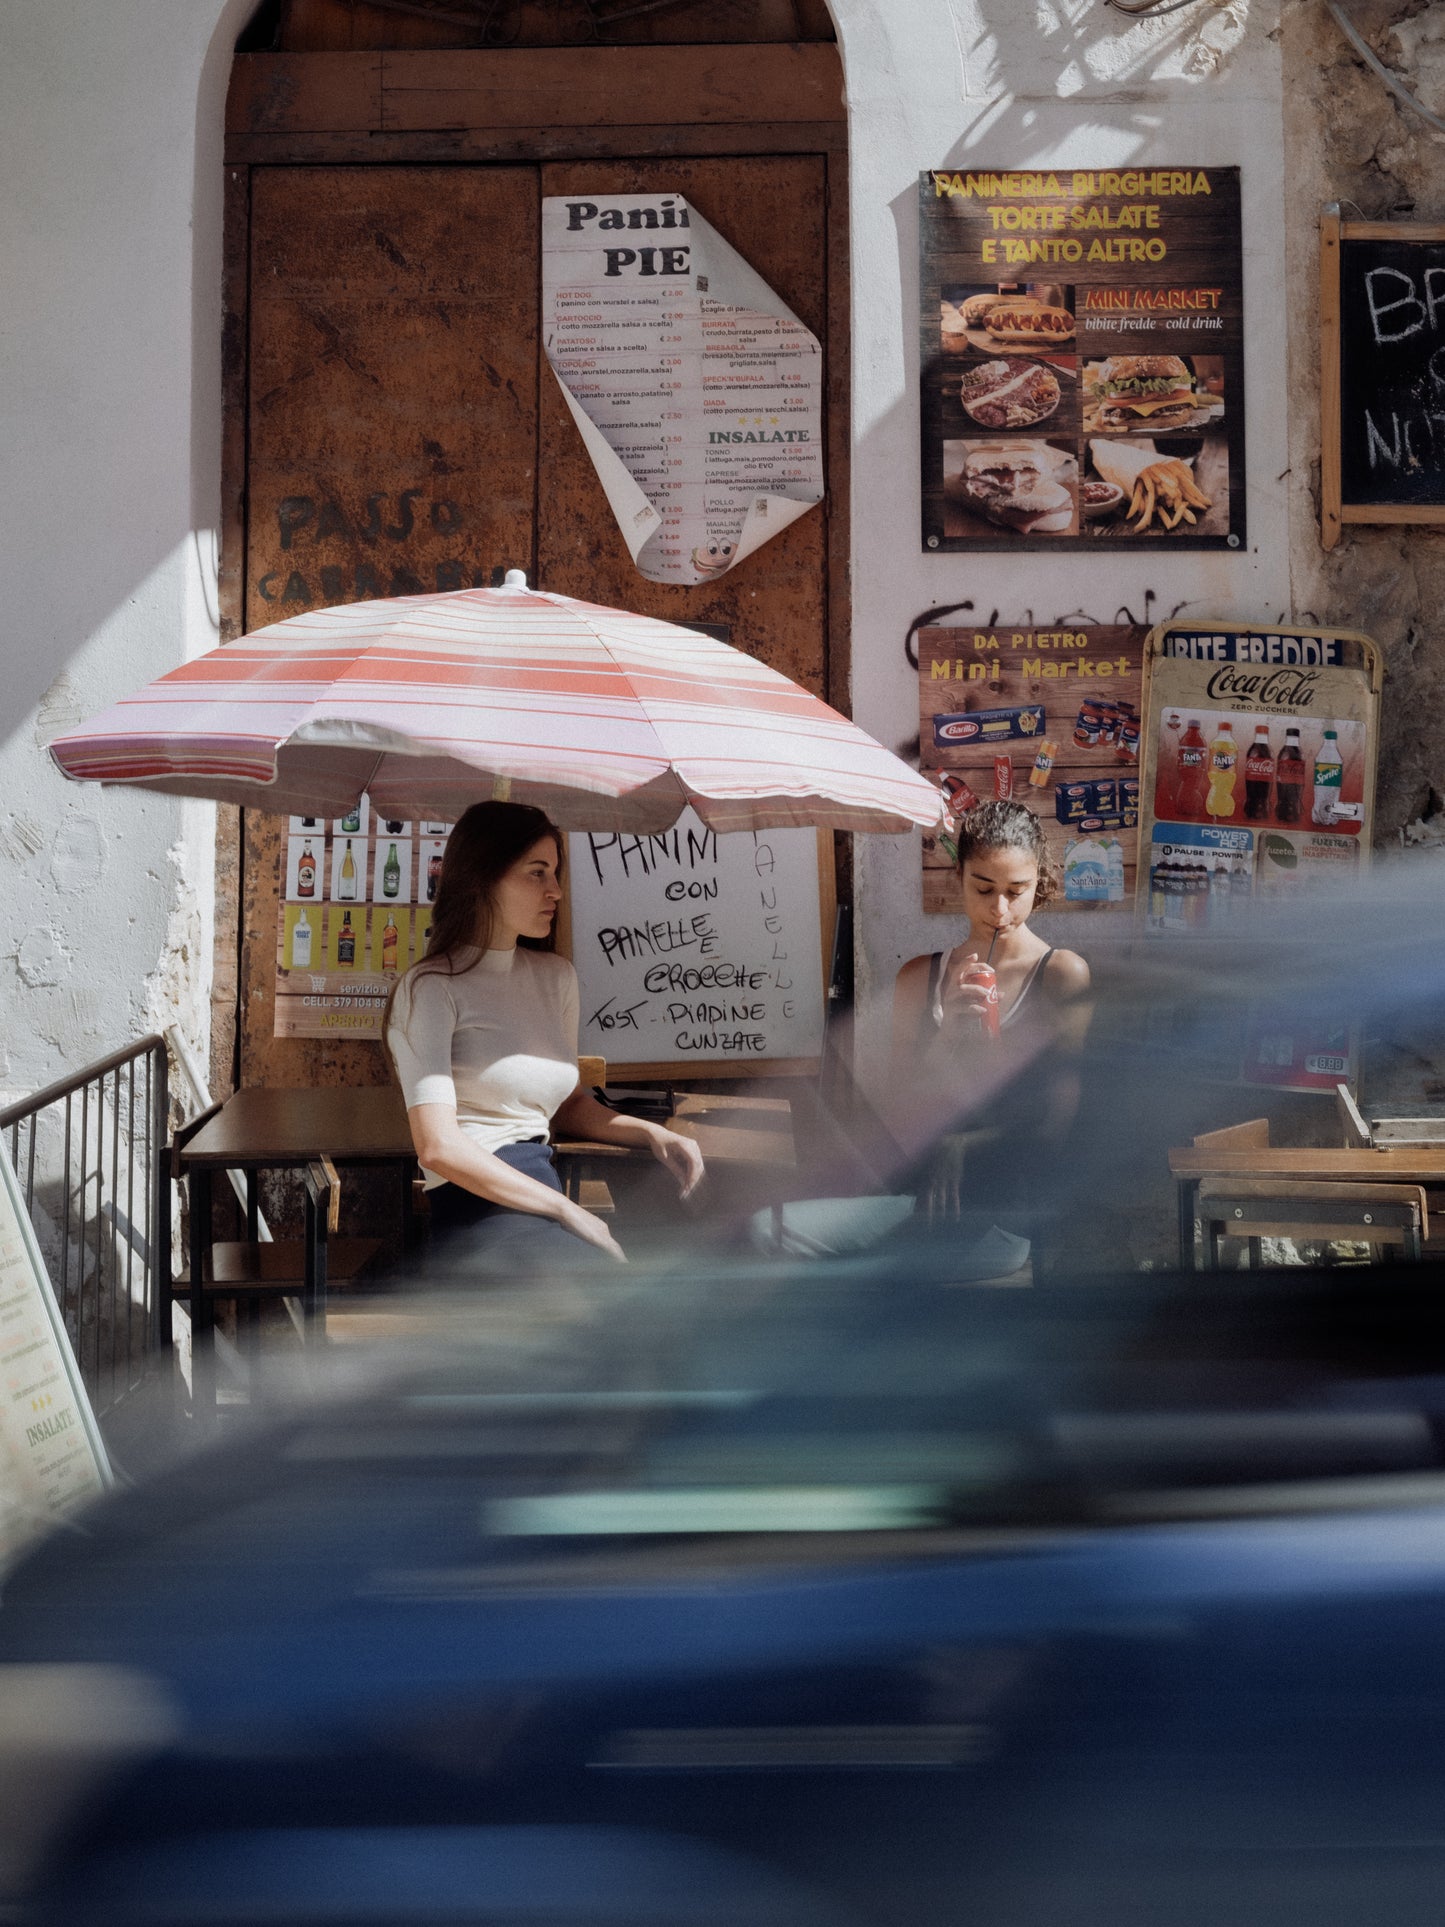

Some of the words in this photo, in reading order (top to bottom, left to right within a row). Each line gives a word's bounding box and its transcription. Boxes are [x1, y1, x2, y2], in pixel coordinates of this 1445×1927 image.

[1072, 171, 1212, 197] BURGHERIA
[987, 205, 1067, 230] TORTE
[1071, 204, 1160, 230] SALATE
[981, 239, 997, 263] E
[1000, 238, 1083, 263] TANTO
[1086, 237, 1166, 262] ALTRO
[1085, 289, 1130, 311] MINI
[1133, 288, 1223, 310] MARKET
[1085, 317, 1117, 330] bibite
[1118, 317, 1156, 332] fredde
[1166, 317, 1190, 330] cold
[1192, 317, 1223, 330] drink
[709, 430, 811, 444] INSALATE
[974, 634, 1000, 649] DA
[1011, 633, 1088, 649] PIETRO
[1235, 636, 1336, 667] FREDDE
[931, 658, 1000, 680] Mini
[1022, 656, 1132, 679] Market
[1206, 665, 1321, 706] Coca-Cola
[1231, 703, 1252, 711] ZERO
[1316, 768, 1340, 785] Sprite
[1201, 829, 1249, 841] POWER
[1174, 848, 1204, 856] PAUSE
[665, 878, 718, 901] CON
[340, 984, 379, 993] servizio
[303, 996, 331, 1007] CELL.
[334, 998, 352, 1008] 379
[354, 998, 372, 1008] 104
[321, 1014, 375, 1028] APERTO
[26, 1407, 75, 1448] INSALATE
